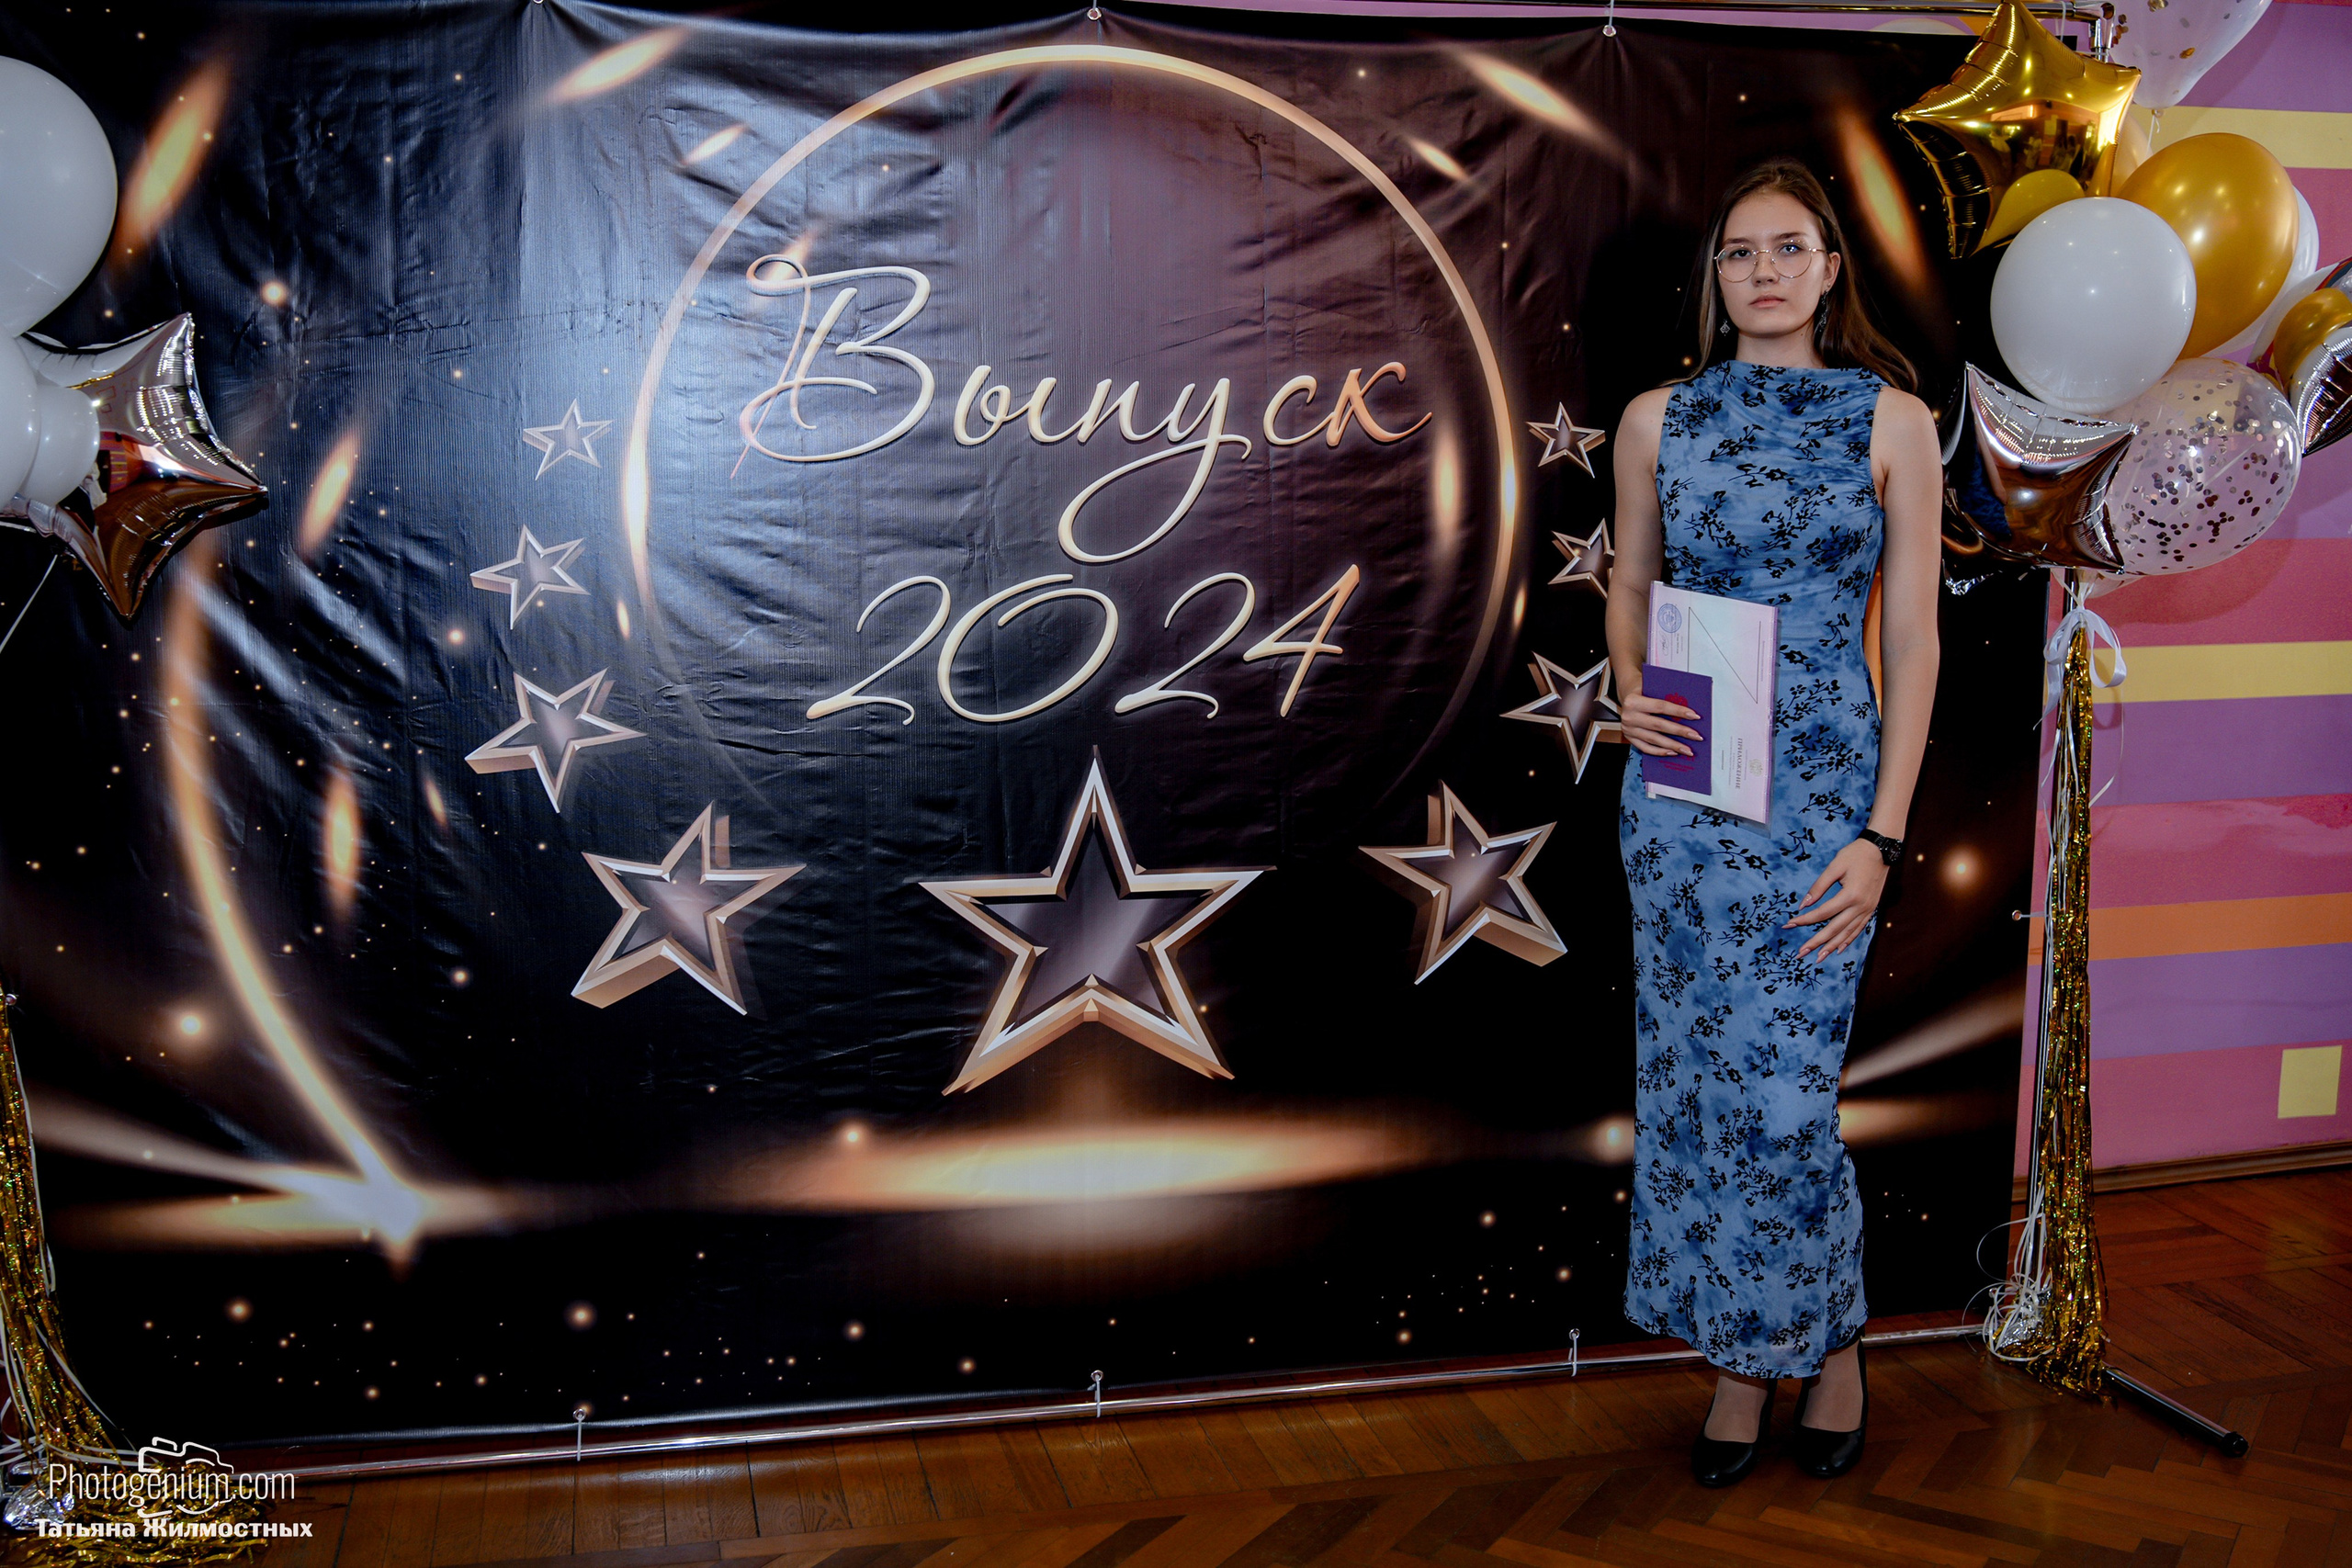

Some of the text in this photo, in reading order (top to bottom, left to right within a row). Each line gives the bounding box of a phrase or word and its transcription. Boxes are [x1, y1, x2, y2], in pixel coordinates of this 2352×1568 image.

[731, 254, 1433, 563] Выпуск
[806, 564, 1361, 726] 2024
[1735, 738, 1744, 789] ПРИЛОЖЕНИЕ
